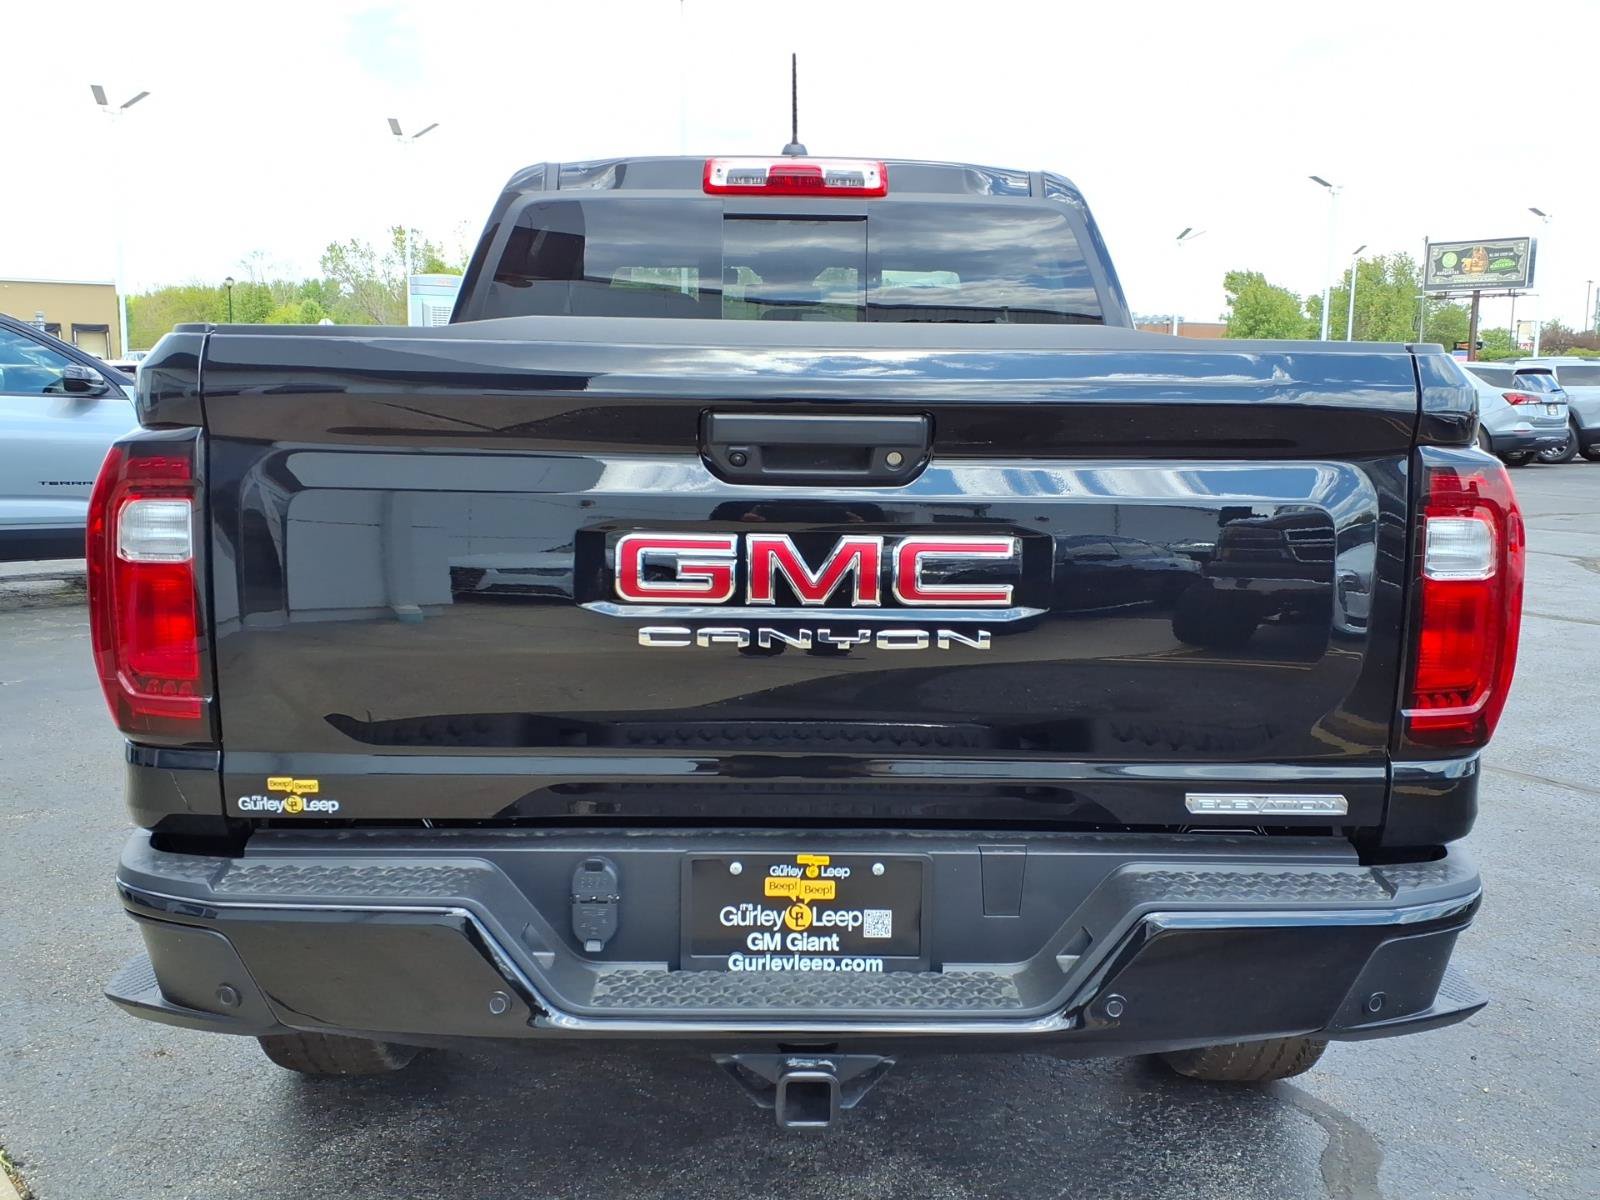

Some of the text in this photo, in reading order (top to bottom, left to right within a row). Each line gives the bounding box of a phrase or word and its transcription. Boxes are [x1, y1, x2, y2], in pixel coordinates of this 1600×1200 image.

[614, 533, 1014, 607] GMC
[638, 626, 991, 650] CANYON
[303, 797, 339, 813] Leep
[1197, 799, 1336, 810] ELEVATION
[821, 866, 850, 879] Leep
[769, 882, 832, 896] Beep! Beep!
[812, 906, 862, 931] Leep
[747, 932, 839, 951] GM Giant
